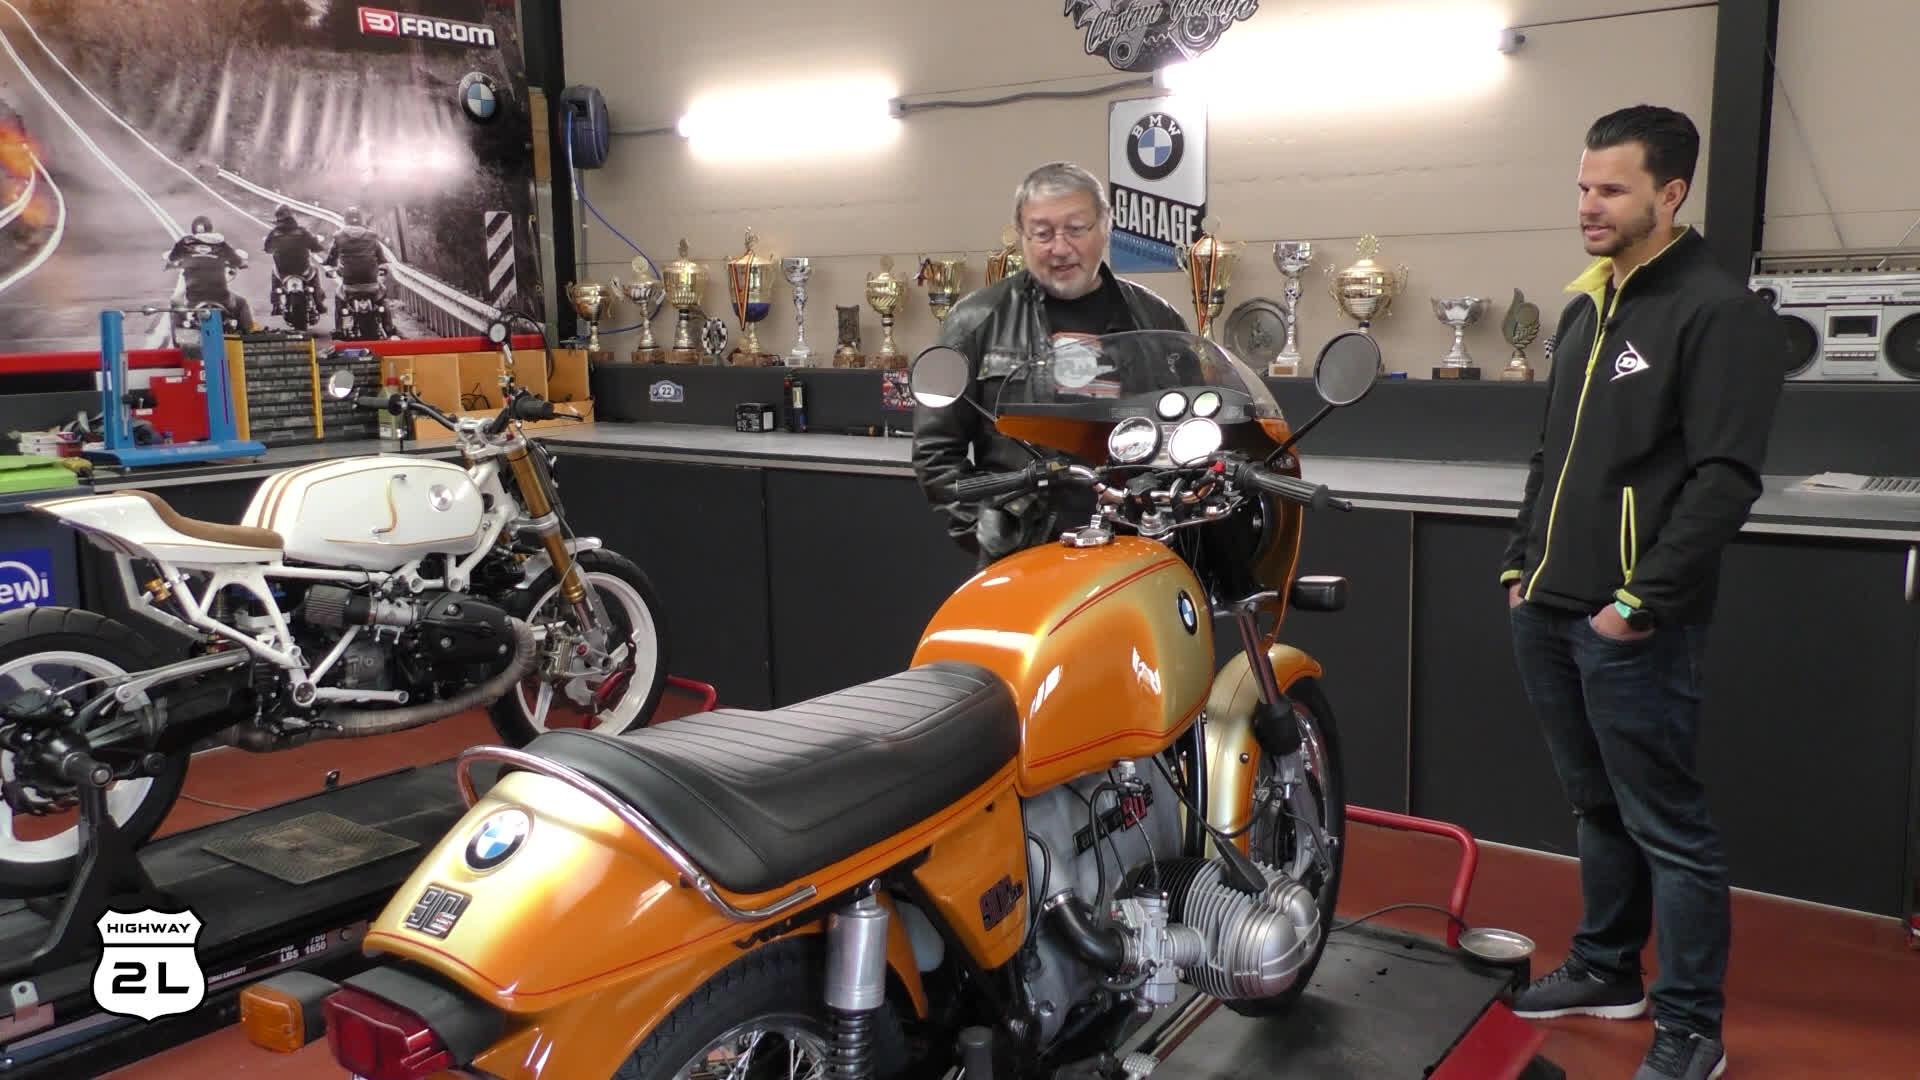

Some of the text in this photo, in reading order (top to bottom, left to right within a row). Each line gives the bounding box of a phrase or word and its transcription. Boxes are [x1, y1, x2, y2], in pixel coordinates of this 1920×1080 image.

[401, 16, 495, 46] FACOM
[1131, 114, 1181, 138] BMW
[1115, 188, 1199, 247] GARAGE
[661, 386, 673, 396] 22
[280, 948, 300, 962] LBS
[304, 941, 328, 955] 1650
